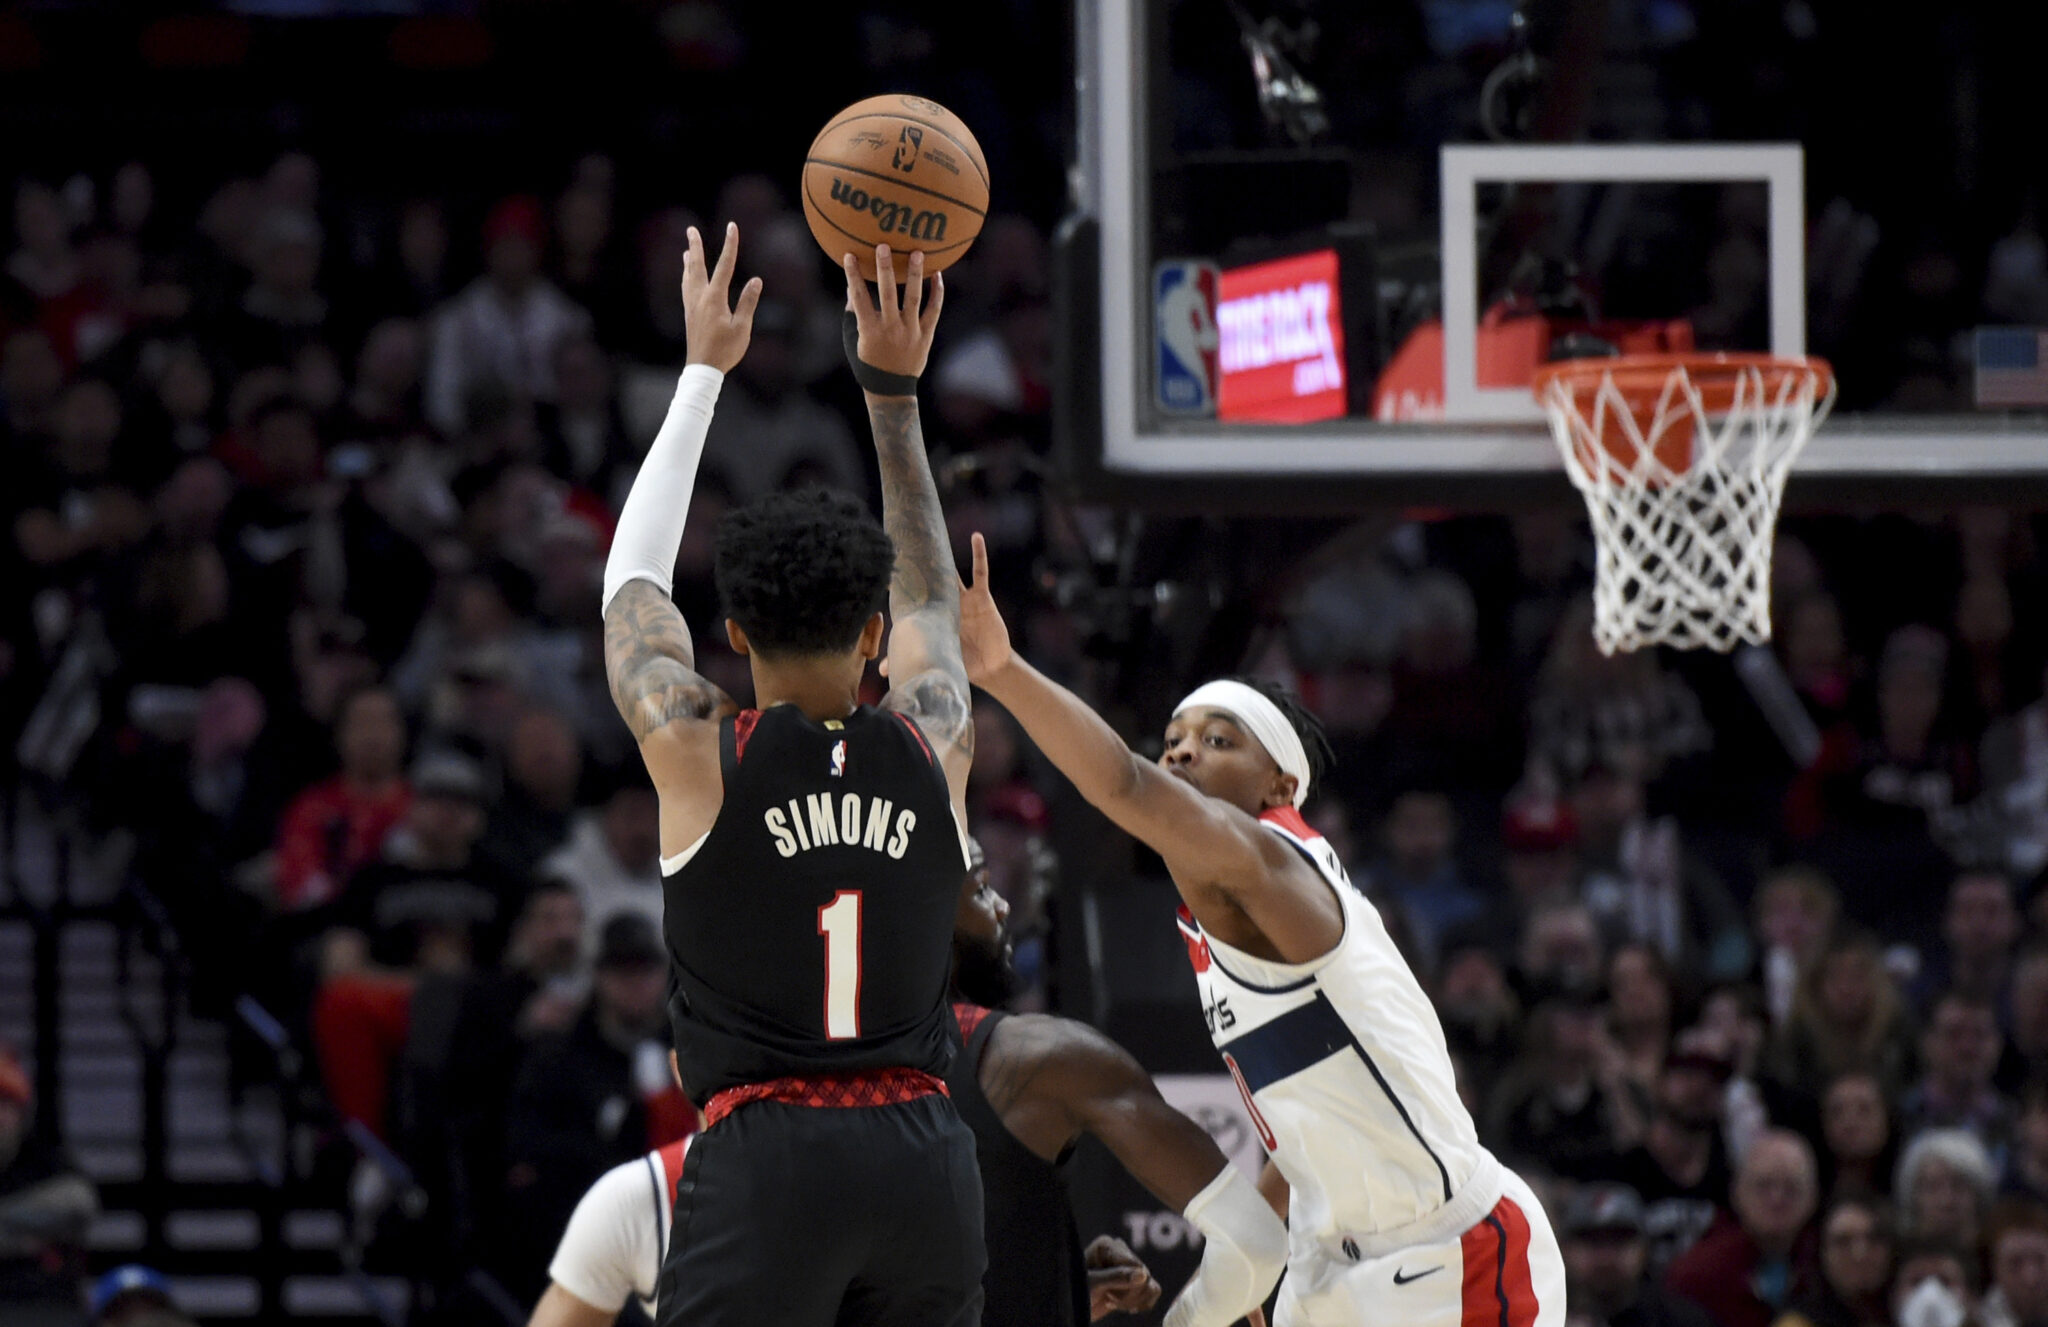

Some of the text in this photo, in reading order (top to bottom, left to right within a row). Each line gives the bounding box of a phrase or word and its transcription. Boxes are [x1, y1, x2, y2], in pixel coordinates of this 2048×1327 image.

[831, 177, 947, 241] Wilson
[763, 791, 917, 860] SIMONS
[816, 889, 863, 1041] 1
